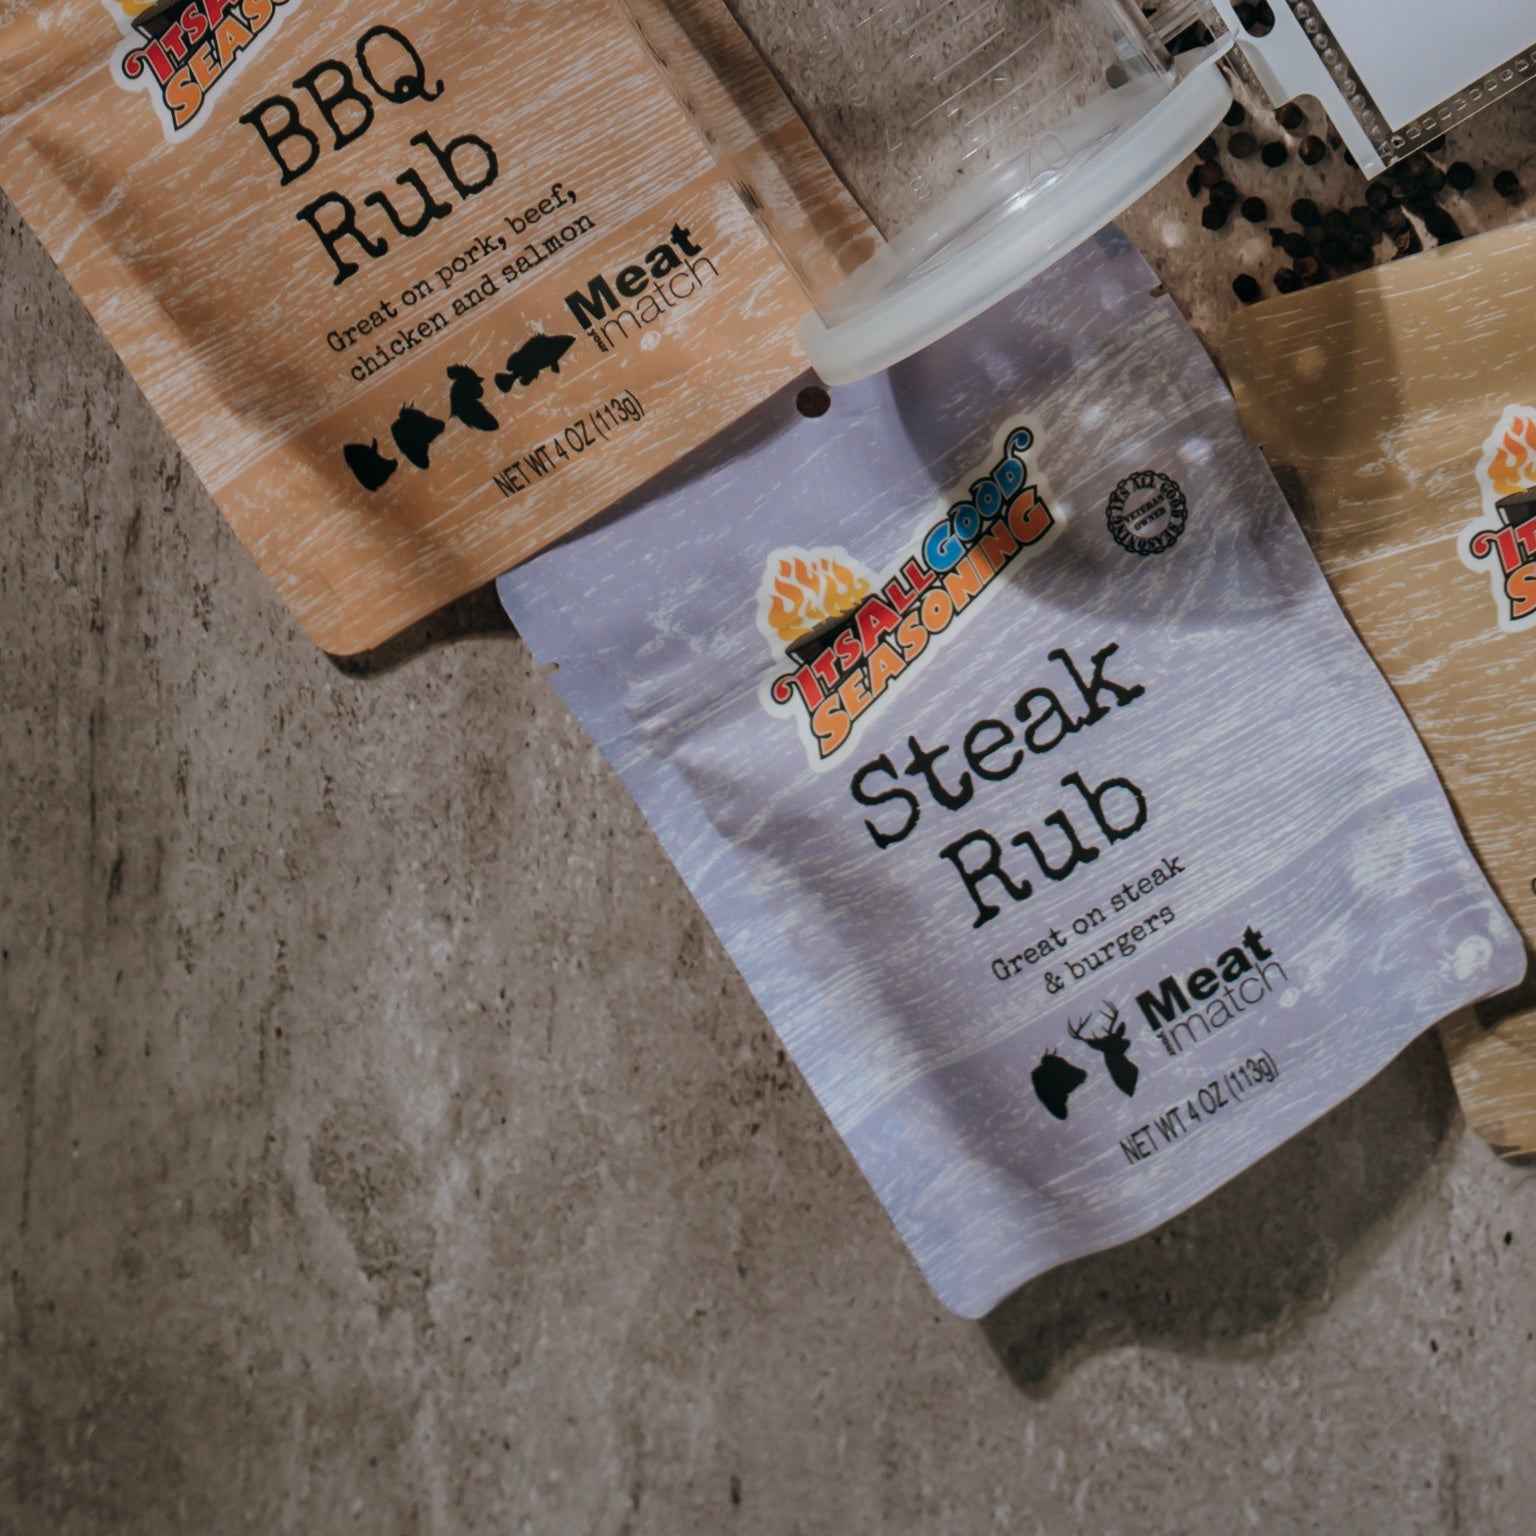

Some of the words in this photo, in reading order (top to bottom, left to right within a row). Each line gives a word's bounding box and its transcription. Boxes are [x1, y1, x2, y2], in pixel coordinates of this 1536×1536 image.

[238, 24, 445, 187] BBQ
[295, 129, 498, 286] Rub
[325, 300, 398, 352] Great
[400, 279, 434, 306] on
[434, 235, 507, 289] pork,
[503, 182, 576, 235] beef,
[350, 312, 449, 381] chicken
[451, 273, 499, 316] and
[501, 214, 595, 283] salmon
[563, 222, 702, 330] Meat
[598, 252, 719, 348] match
[491, 460, 531, 498] NET
[522, 444, 556, 477] WT
[553, 438, 569, 459] 4
[563, 419, 595, 453] OZ
[588, 389, 644, 438] (113g)
[811, 485, 1055, 760] SEASONING
[849, 642, 1145, 850] Steak
[938, 770, 1147, 929] Rub
[990, 927, 1067, 981] Great
[1071, 907, 1106, 934] on
[1110, 856, 1185, 912] steak
[1043, 971, 1065, 994] &
[1063, 905, 1175, 980] burgers
[1134, 925, 1272, 1031] Meat
[1167, 960, 1288, 1052] match
[1118, 1123, 1158, 1164] NET
[1153, 1106, 1187, 1142] WT
[1186, 1100, 1201, 1122] 4
[1197, 1081, 1228, 1115] OZ
[1224, 1051, 1279, 1101] (113g)
